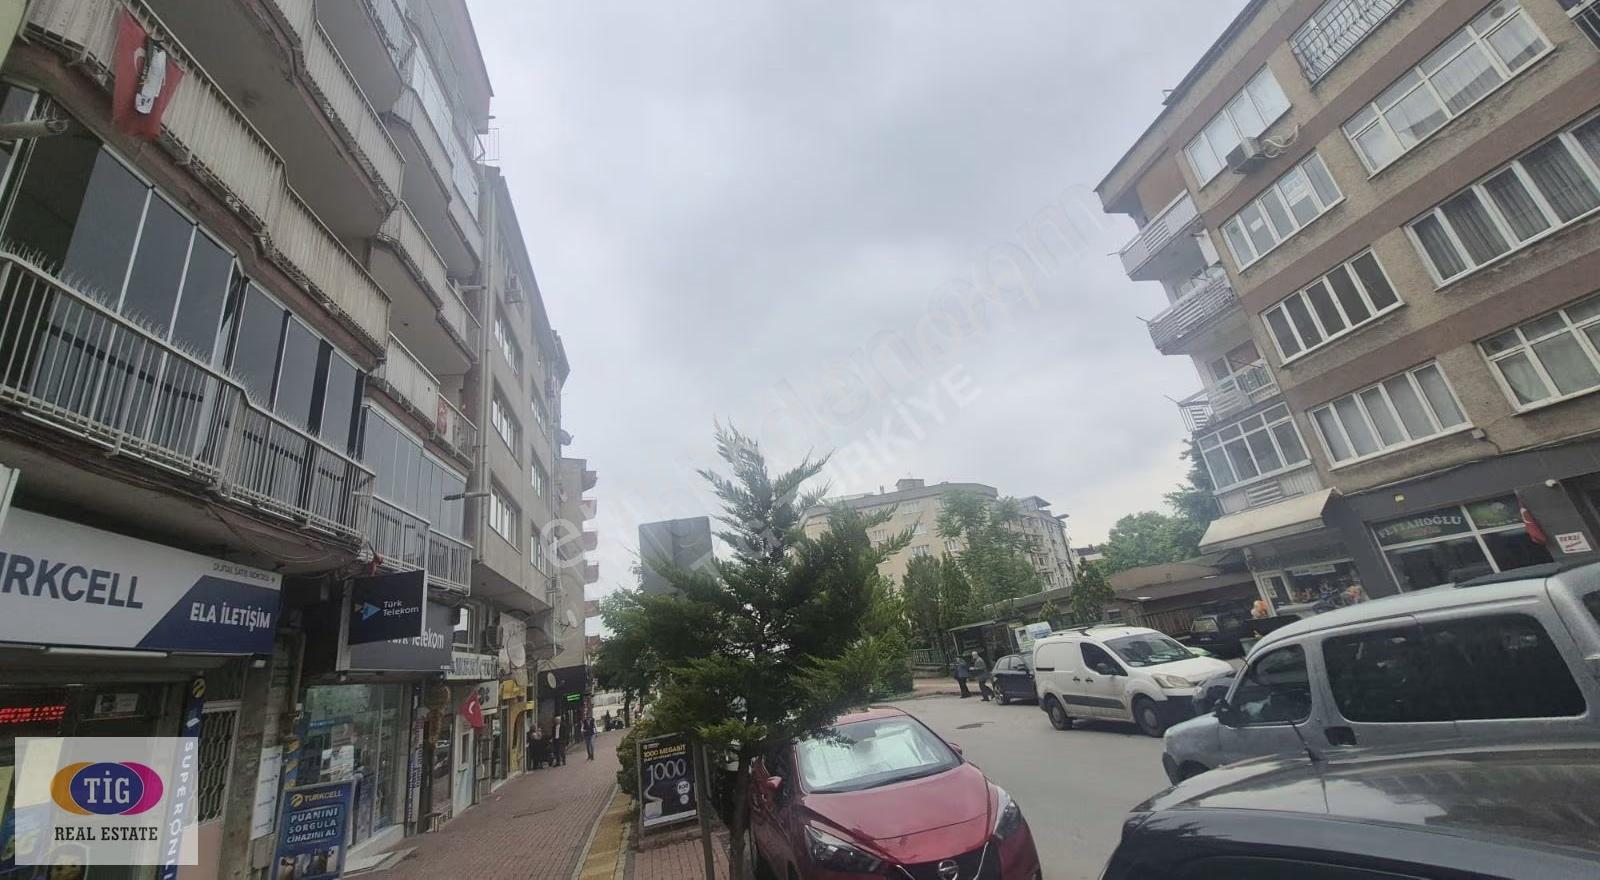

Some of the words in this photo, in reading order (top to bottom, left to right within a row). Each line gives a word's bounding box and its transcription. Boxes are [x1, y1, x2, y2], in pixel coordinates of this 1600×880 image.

[383, 600, 402, 609] Türk
[383, 606, 419, 617] Telekom
[190, 602, 216, 624] ELA
[220, 601, 271, 632] İLETİŞİM
[646, 758, 687, 782] 1000
[304, 790, 343, 803] TURKCELL
[291, 808, 338, 823] PUANINI
[288, 819, 337, 834] SORGULA
[324, 829, 336, 838] AL
